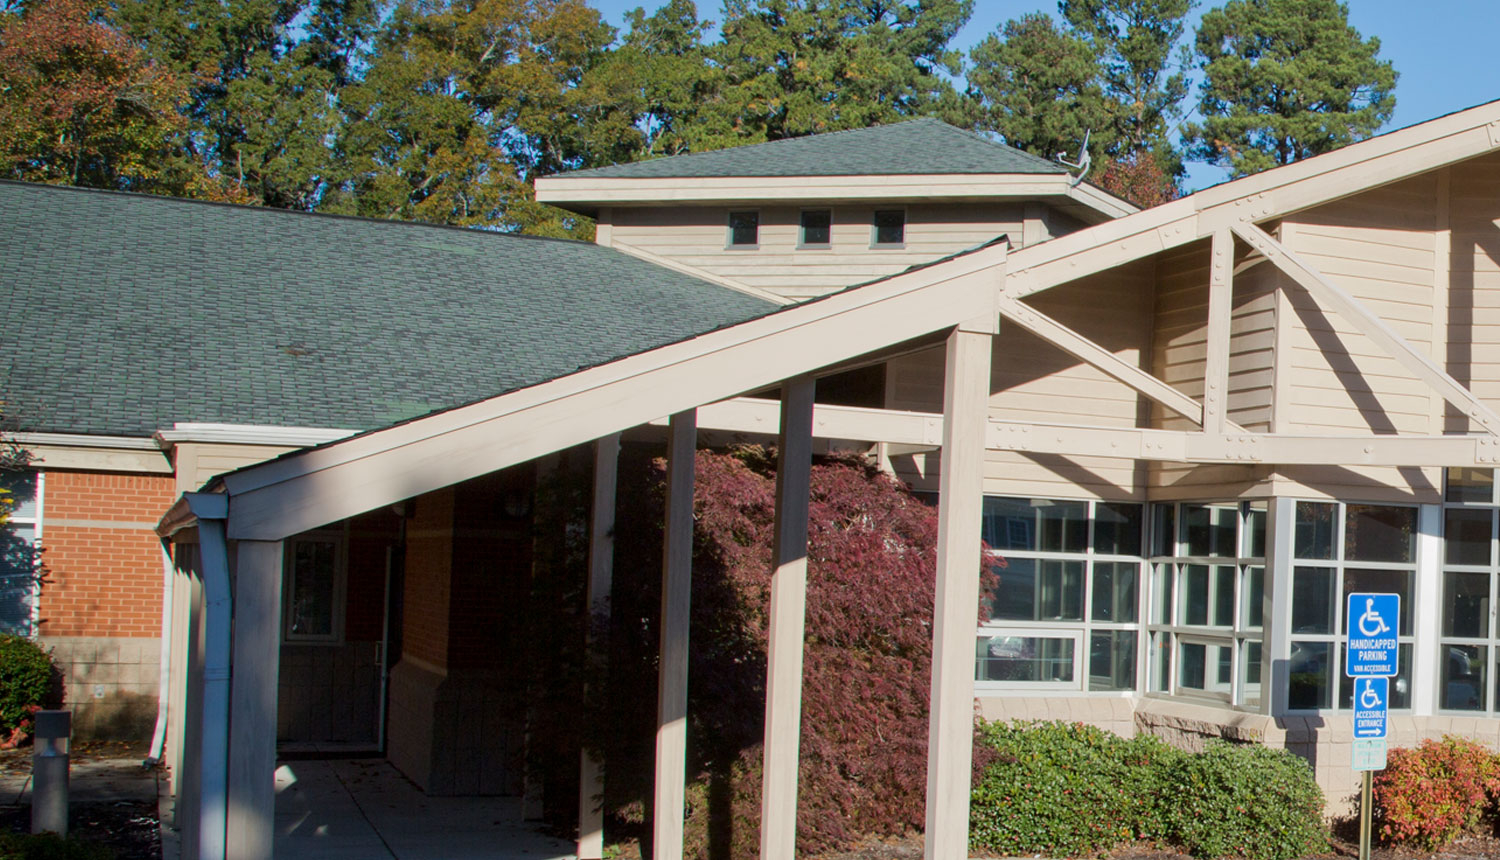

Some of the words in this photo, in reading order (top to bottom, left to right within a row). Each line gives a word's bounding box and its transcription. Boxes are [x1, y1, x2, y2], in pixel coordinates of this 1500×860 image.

[1350, 639, 1396, 650] HANDICAPPED
[1358, 650, 1387, 661] PARKING
[1356, 710, 1385, 719] ACCESSIBLE
